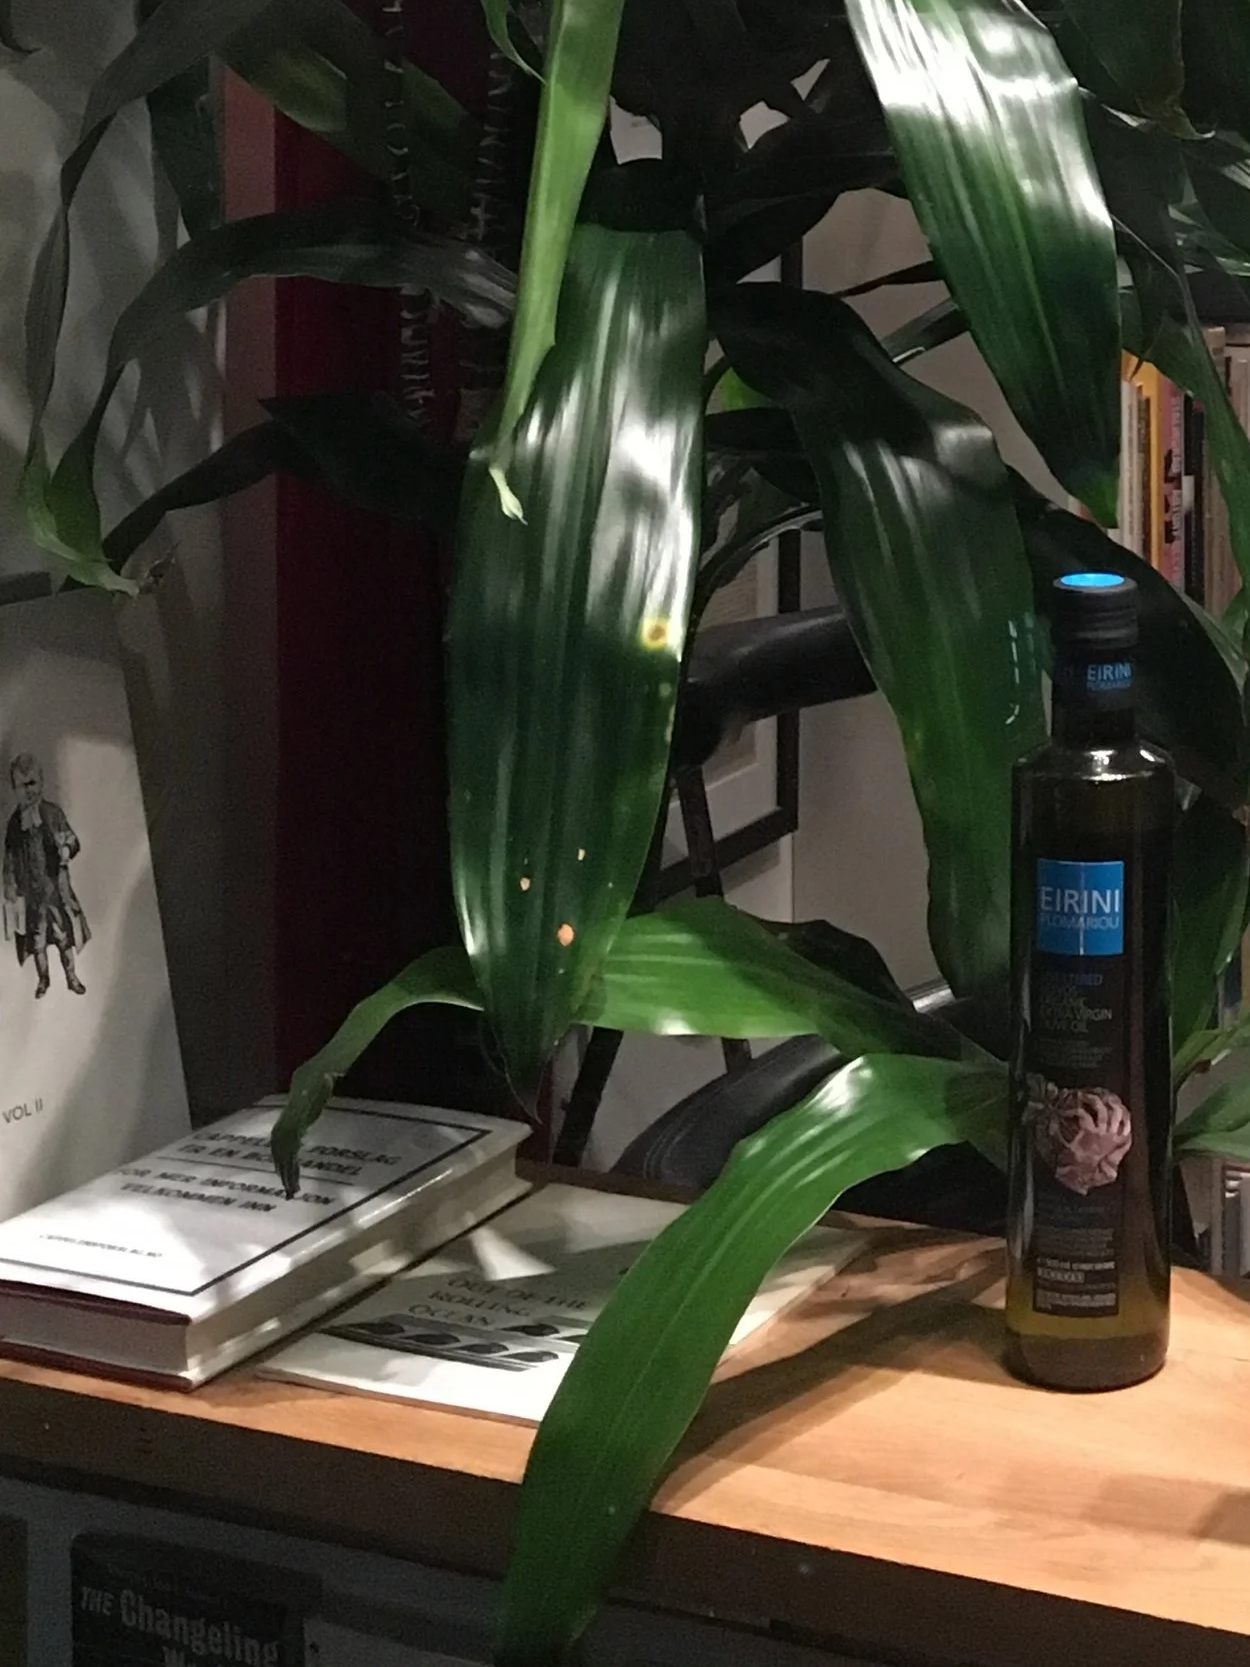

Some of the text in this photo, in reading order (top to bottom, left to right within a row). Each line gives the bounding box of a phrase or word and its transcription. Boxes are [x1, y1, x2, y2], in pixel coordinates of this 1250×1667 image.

[1039, 885, 1120, 915] EIRINI
[2, 1103, 32, 1123] VOL
[209, 1147, 241, 1158] EN
[306, 1145, 402, 1166] FORSLAG
[505, 1289, 535, 1301] OF
[543, 1295, 587, 1311] THE
[81, 1586, 114, 1616] THE
